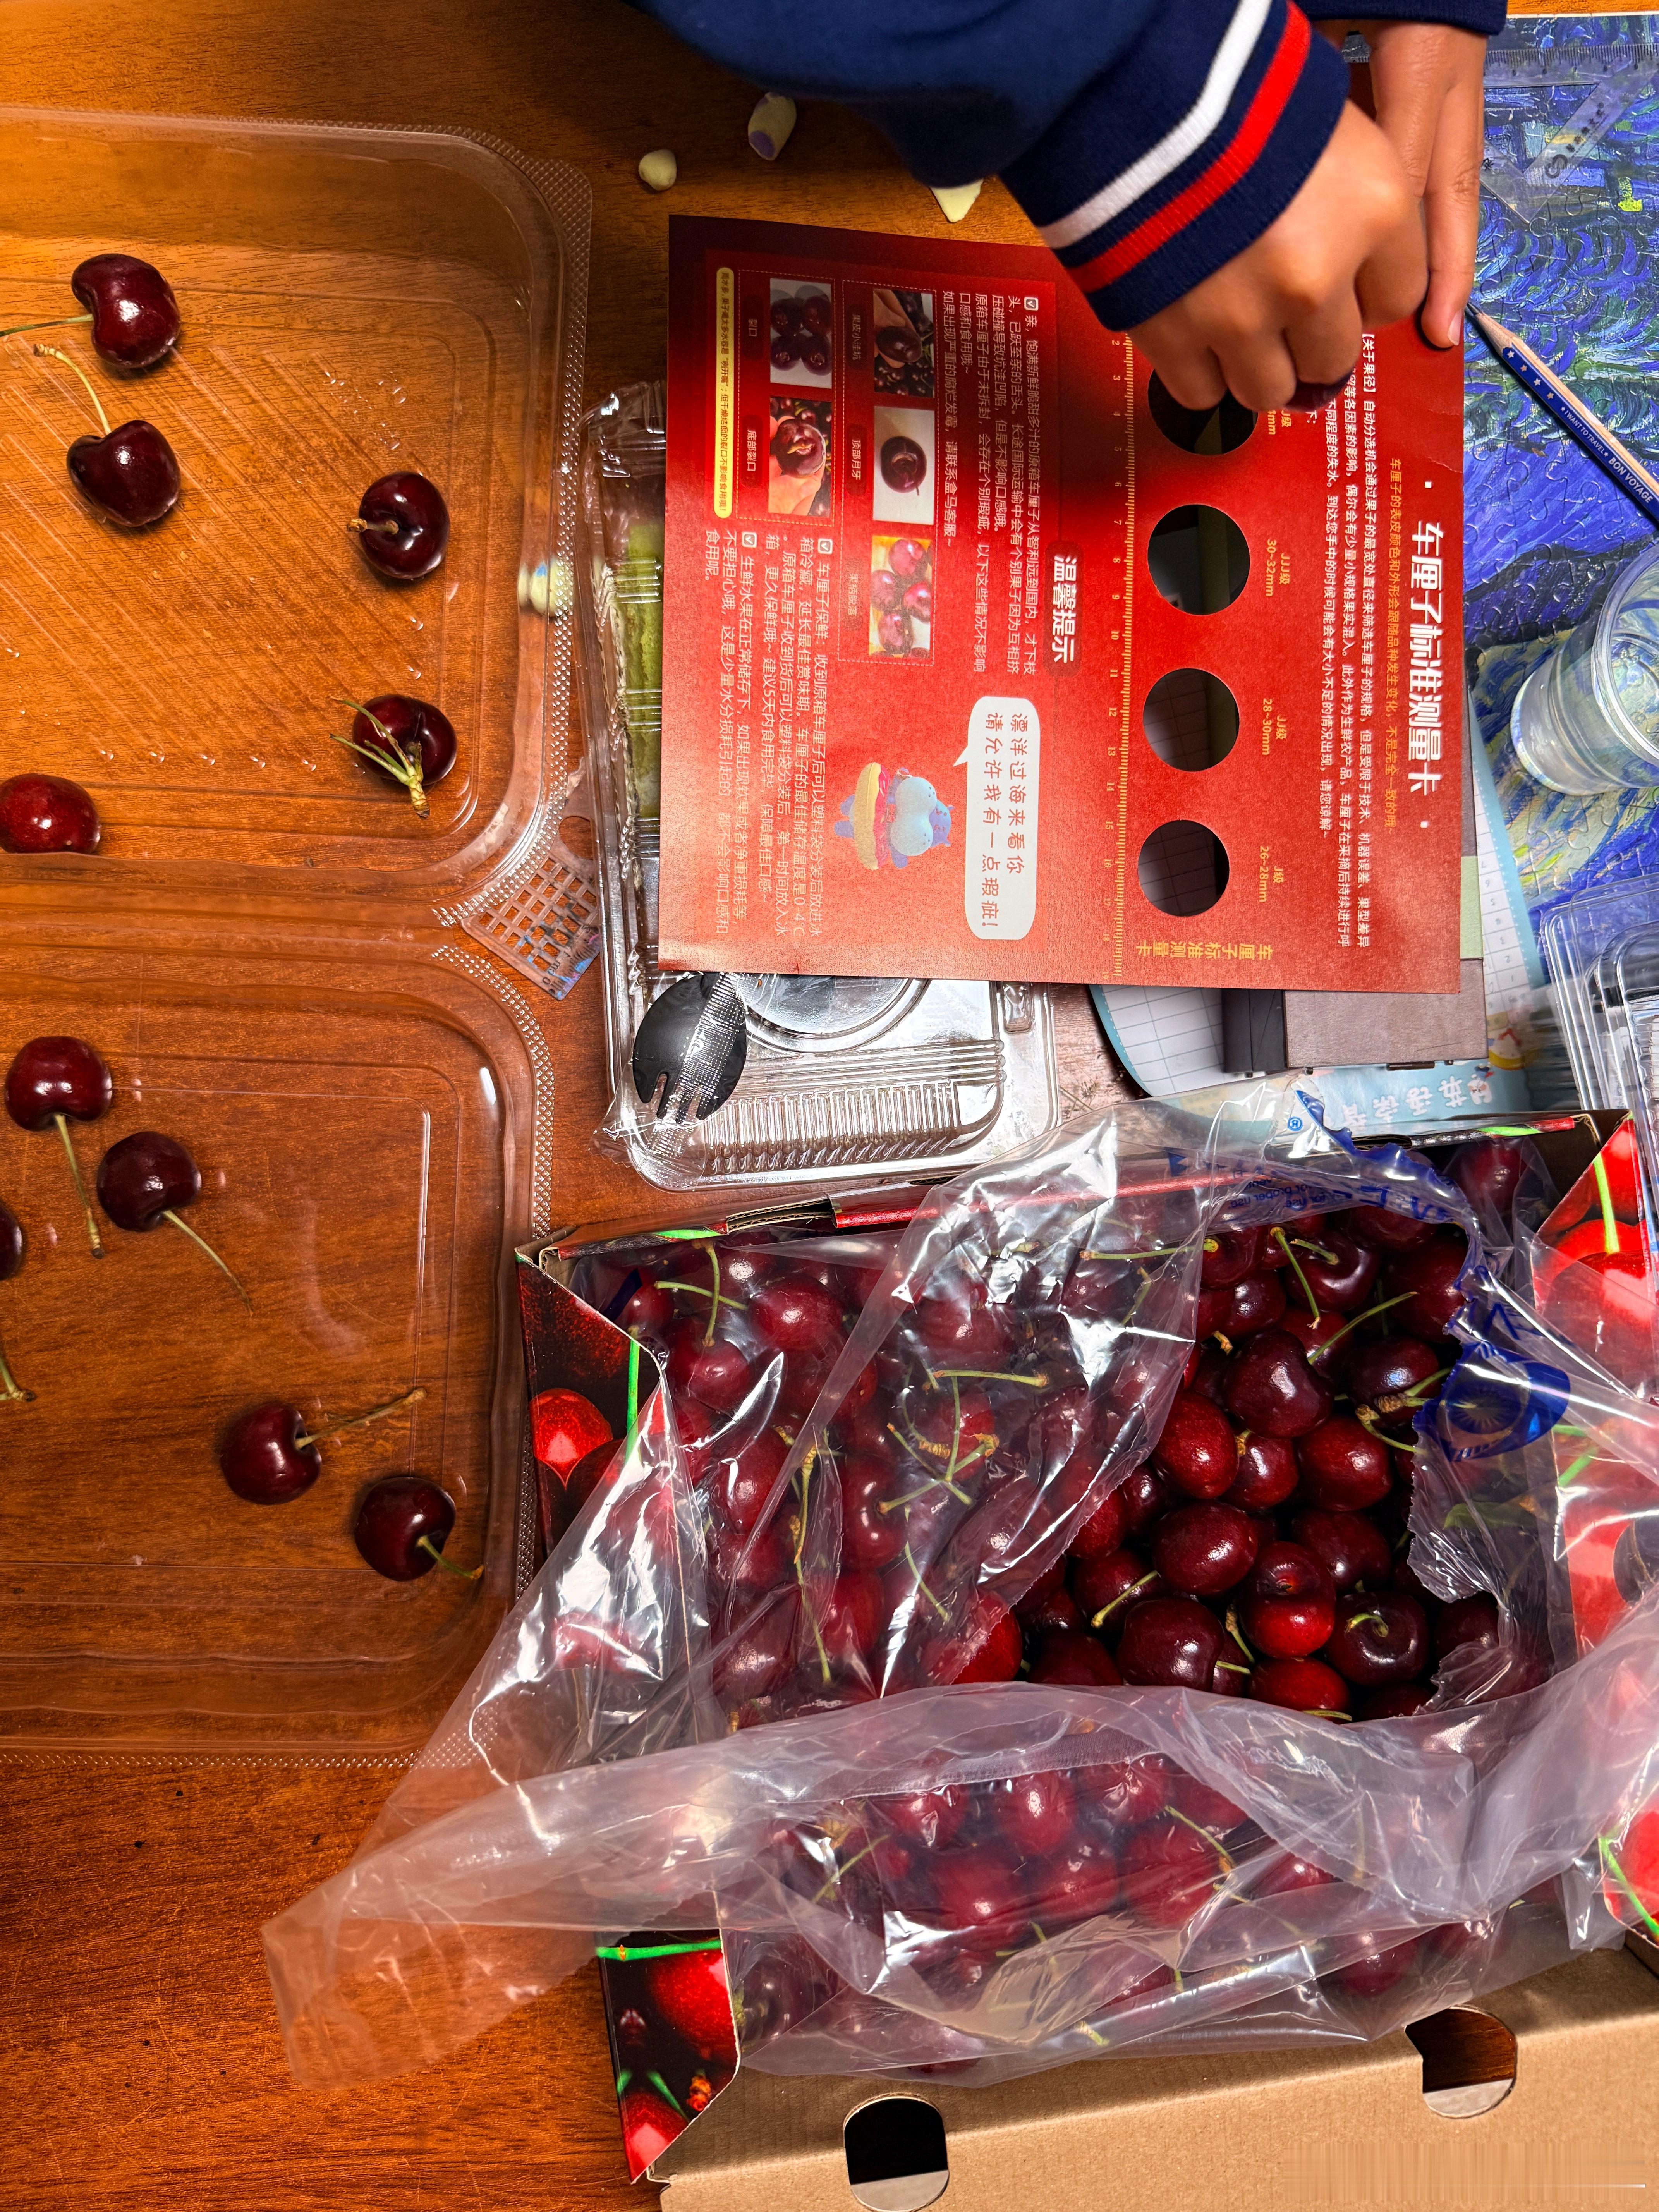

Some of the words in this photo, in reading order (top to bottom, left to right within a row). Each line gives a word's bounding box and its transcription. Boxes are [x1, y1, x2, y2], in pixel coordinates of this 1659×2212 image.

[748, 319, 757, 337] 裂口
[960, 293, 973, 374] 口感和食用哦~
[992, 295, 1007, 532] 压碰撞导致坑洼凹陷，但是不影响口感哦。
[746, 430, 757, 471] 底部裂口
[851, 439, 862, 480] 顶部月牙
[1566, 413, 1582, 429] WANT
[1580, 427, 1589, 435] TO
[1587, 433, 1606, 454] TRAVEL
[1608, 457, 1626, 475] BON
[1625, 472, 1654, 503] VOYAGE
[973, 293, 991, 673] 原箱车厘子由于未拆封，会存在个别瑕疵，以下这些情况不影响
[1006, 295, 1024, 674] 头，已跃至亲的舌头。长途国际运输中会有个别果子因为互相挤
[705, 529, 719, 580] 食用呢。
[1265, 539, 1277, 596] 30~32mm
[1279, 553, 1290, 585] JJJ级
[847, 573, 858, 616] 果柄脱落
[1052, 555, 1077, 663] 温馨提示
[1111, 630, 1119, 640] 10
[1383, 458, 1401, 834] 车厘子的表皮颜色和外形会跟随品种发生变化，不是完全一致的哦~
[1110, 669, 1118, 678] 11
[1337, 368, 1358, 948] 留等各因素的影响，偶尔会有少量小规格果实混入。此外作为生鲜农产品，车厘子在采摘后持续进行呼
[1408, 521, 1444, 795] 车厘子标准测量卡
[1109, 707, 1117, 716] 12
[1262, 698, 1273, 755] 28~30mm
[1275, 715, 1286, 740] JJ级
[1108, 746, 1116, 756] 13
[1007, 713, 1028, 874] 漂洋过海来看你
[1106, 782, 1114, 791] 14
[1105, 821, 1113, 830] 15
[1104, 859, 1112, 867] 16
[1259, 845, 1269, 902] 26~28mm
[1273, 866, 1284, 883] J级
[1135, 940, 1273, 960] 车厘子标准测量卡
